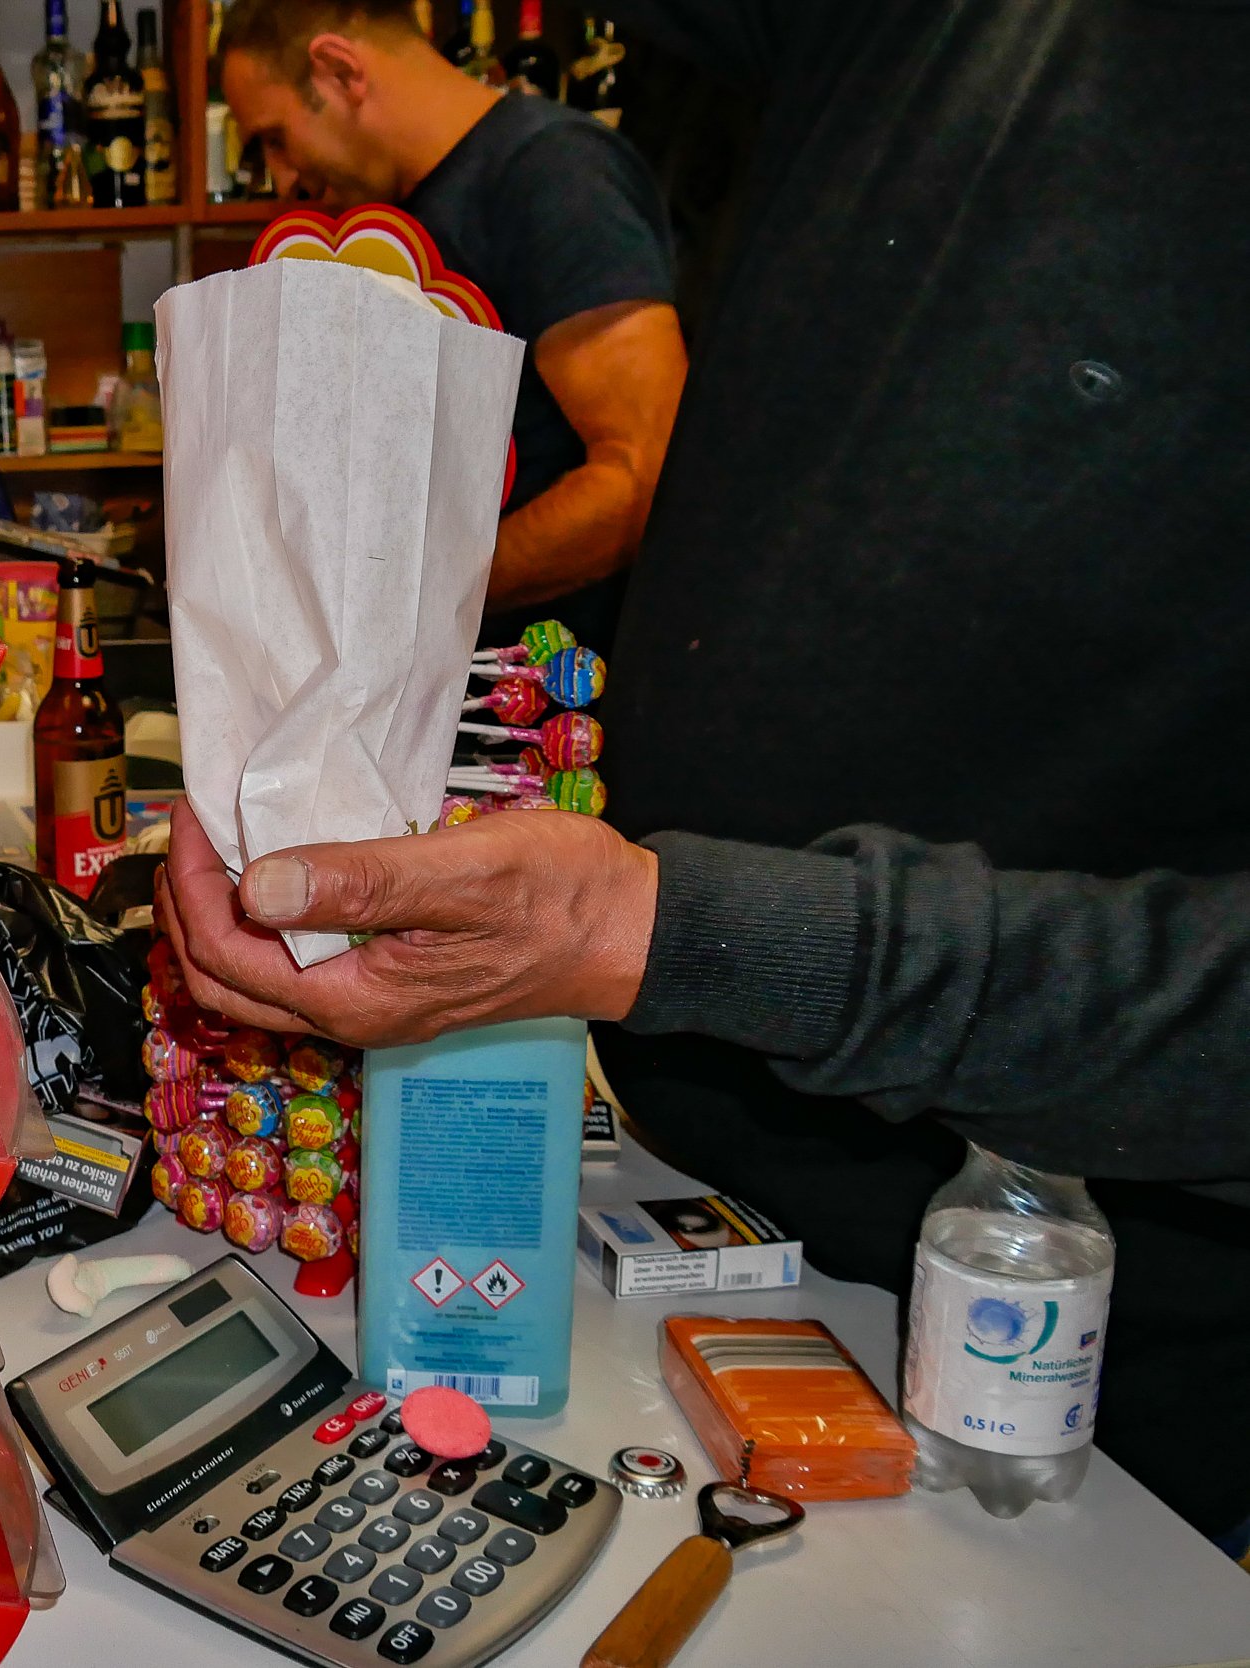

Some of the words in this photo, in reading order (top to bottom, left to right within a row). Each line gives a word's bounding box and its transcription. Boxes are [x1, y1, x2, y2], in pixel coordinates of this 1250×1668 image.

[73, 848, 123, 877] EXP
[19, 1161, 60, 1183] erhöht
[65, 1158, 81, 1172] zu
[81, 1162, 118, 1188] Risiko
[61, 1174, 113, 1203] Rauchen
[37, 1223, 64, 1241] YOU
[1032, 1356, 1093, 1371] Natürliches
[58, 1361, 99, 1393] GENIE
[1009, 1367, 1091, 1383] Mineralwasser
[291, 1393, 307, 1409] Dual
[306, 1382, 326, 1398] Power
[325, 1418, 346, 1432] CE
[963, 1414, 987, 1431] 0,5
[320, 1456, 348, 1476] MRC
[146, 1477, 192, 1514] Electronic
[191, 1445, 235, 1480] Calculator
[363, 1477, 385, 1490] 9
[282, 1481, 313, 1503] TAX+
[331, 1503, 354, 1518] 8
[409, 1496, 431, 1510] 6
[247, 1509, 277, 1530] TAX-
[453, 1516, 477, 1531] 3
[293, 1529, 316, 1547] 7
[374, 1523, 398, 1538] 5
[207, 1537, 243, 1562] RATE
[420, 1543, 447, 1559] 2
[343, 1551, 364, 1567] 4
[388, 1573, 410, 1588] 1
[464, 1560, 498, 1584] 00
[434, 1595, 458, 1612] 0
[344, 1603, 372, 1626] MU
[390, 1624, 420, 1650] OFF
